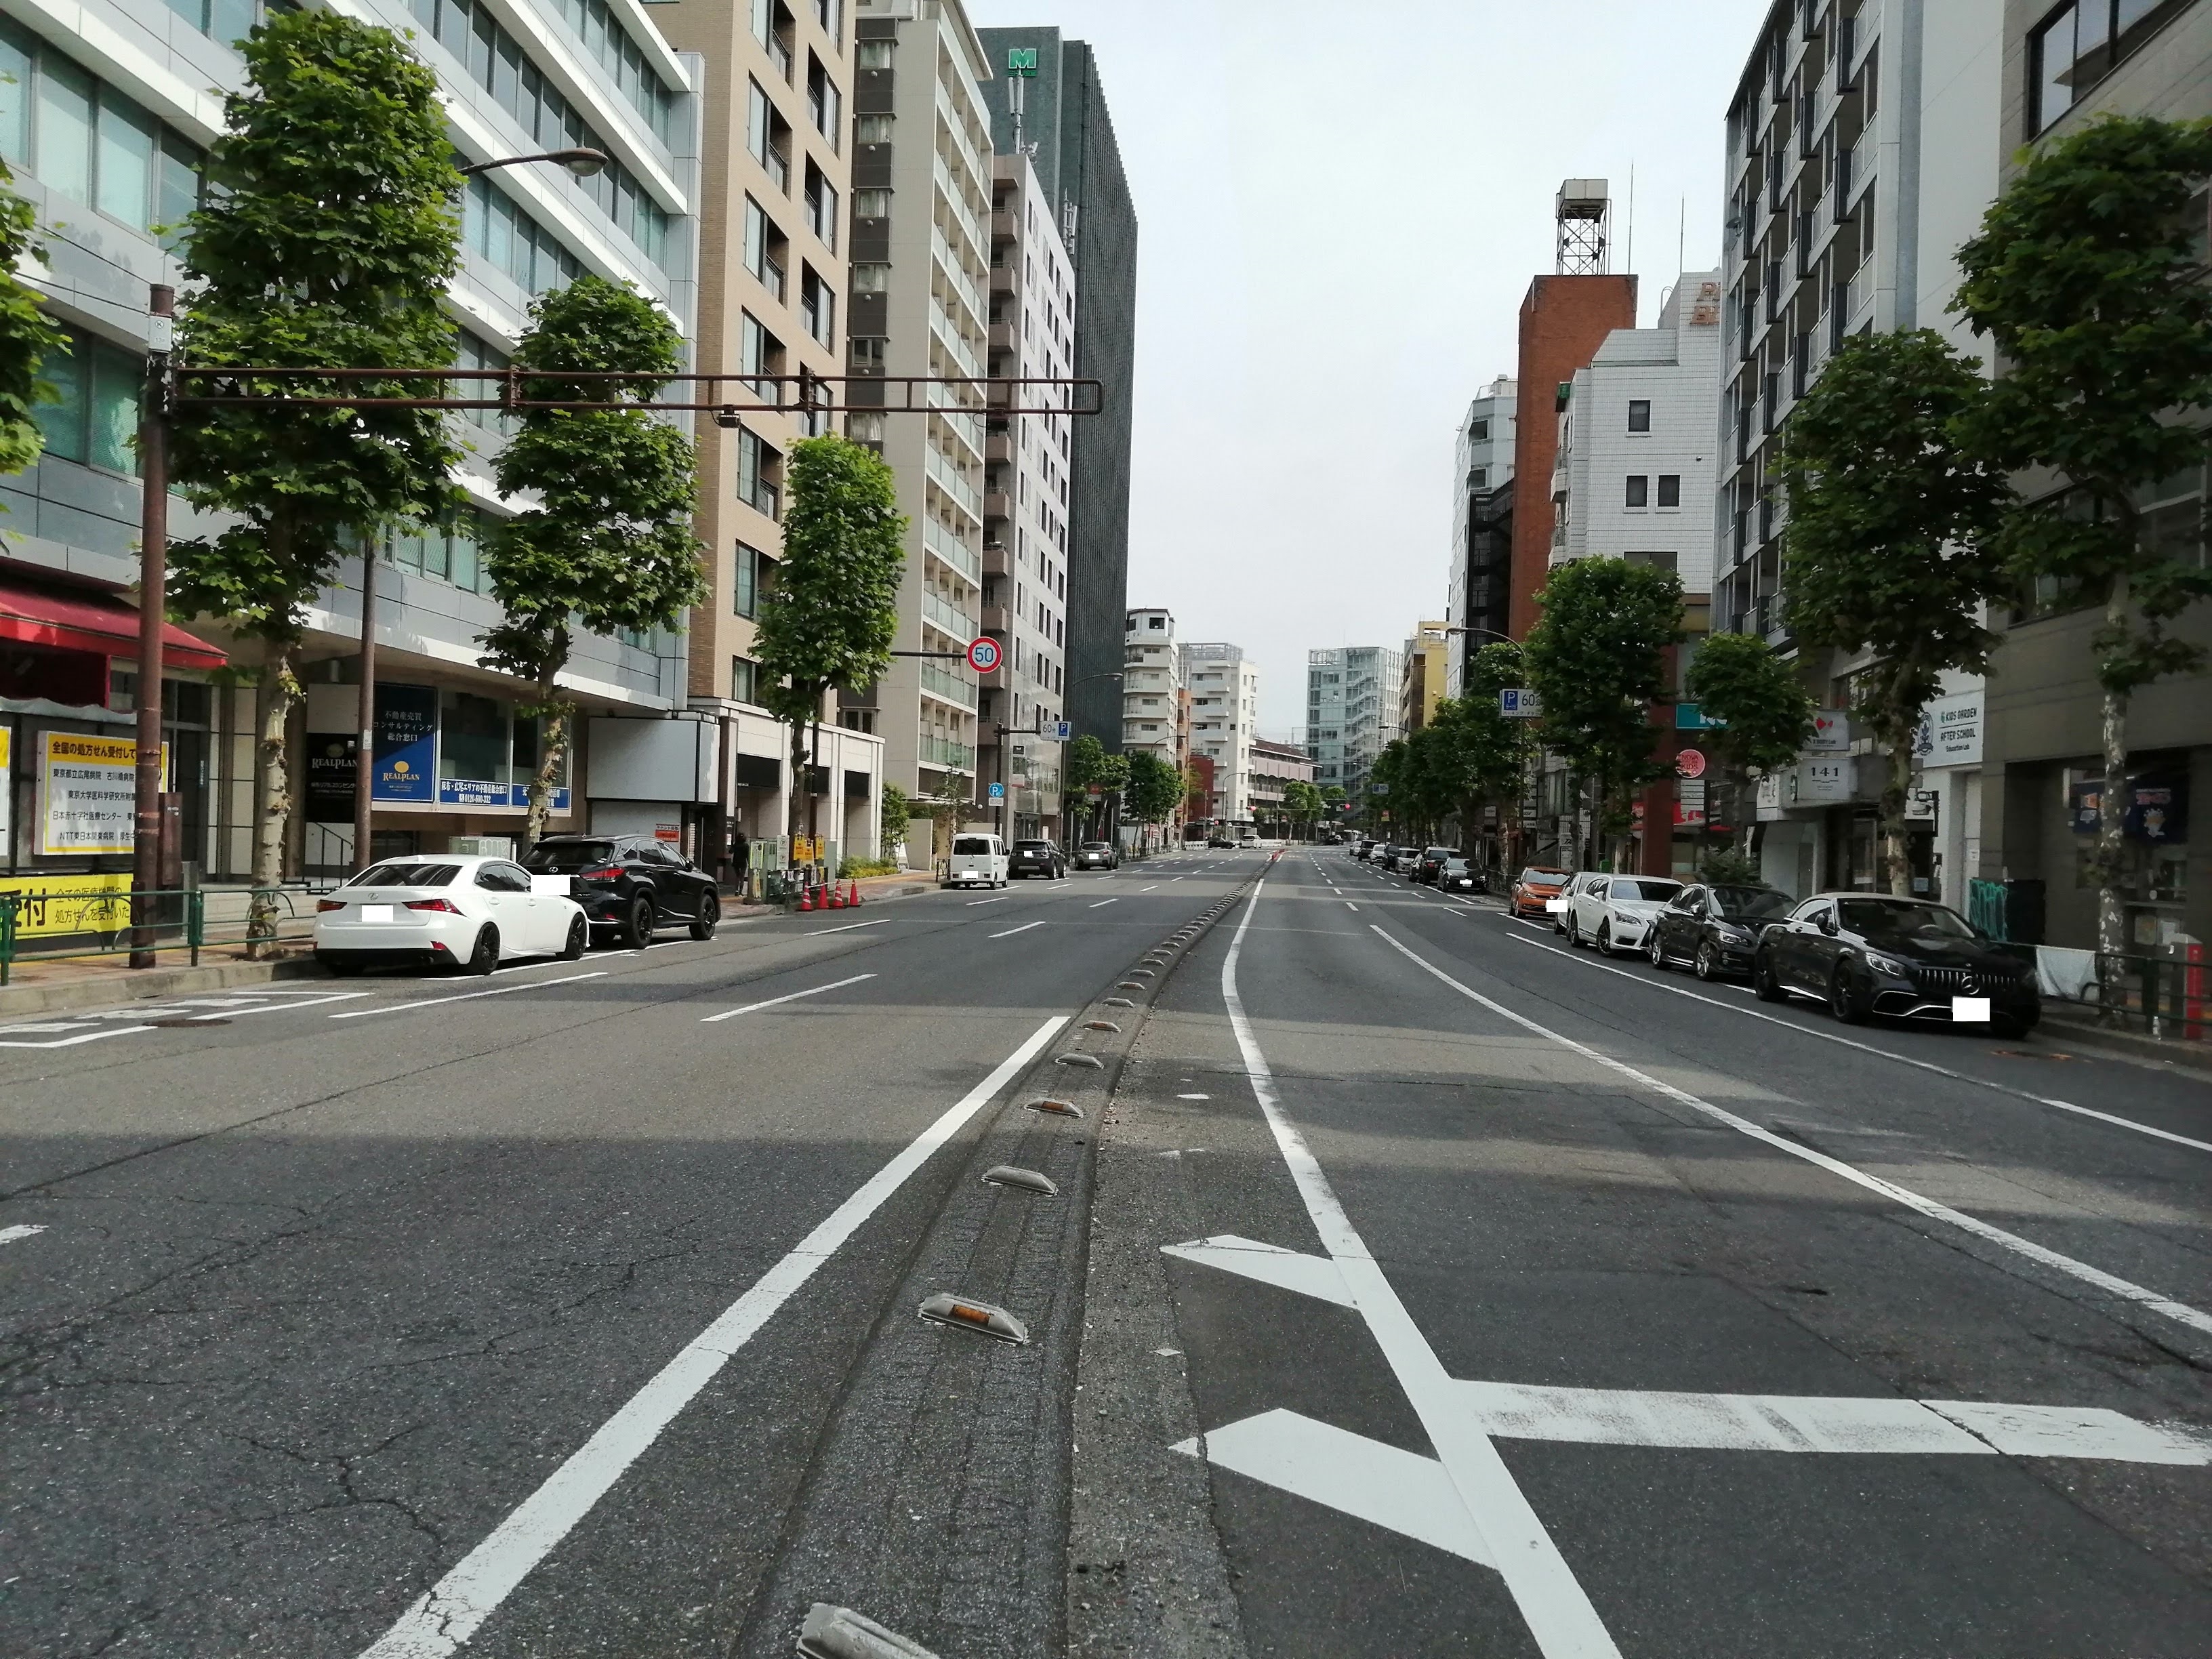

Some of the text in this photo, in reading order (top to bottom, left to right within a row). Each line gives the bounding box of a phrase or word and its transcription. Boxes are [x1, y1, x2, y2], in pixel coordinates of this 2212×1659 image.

[1008, 48, 1037, 69] M
[975, 647, 994, 663] 50
[1508, 692, 1515, 703] P
[384, 710, 422, 720] 不動産売買
[373, 721, 434, 731] コンサルティング
[1061, 723, 1067, 731] P
[387, 733, 418, 742] 総合窓口
[1940, 728, 1976, 742] AFTER SCHOOL
[53, 769, 102, 780] 東京都立広尾病院
[1811, 766, 1839, 777] 141
[53, 811, 121, 821] 日本赤十字社医療センター
